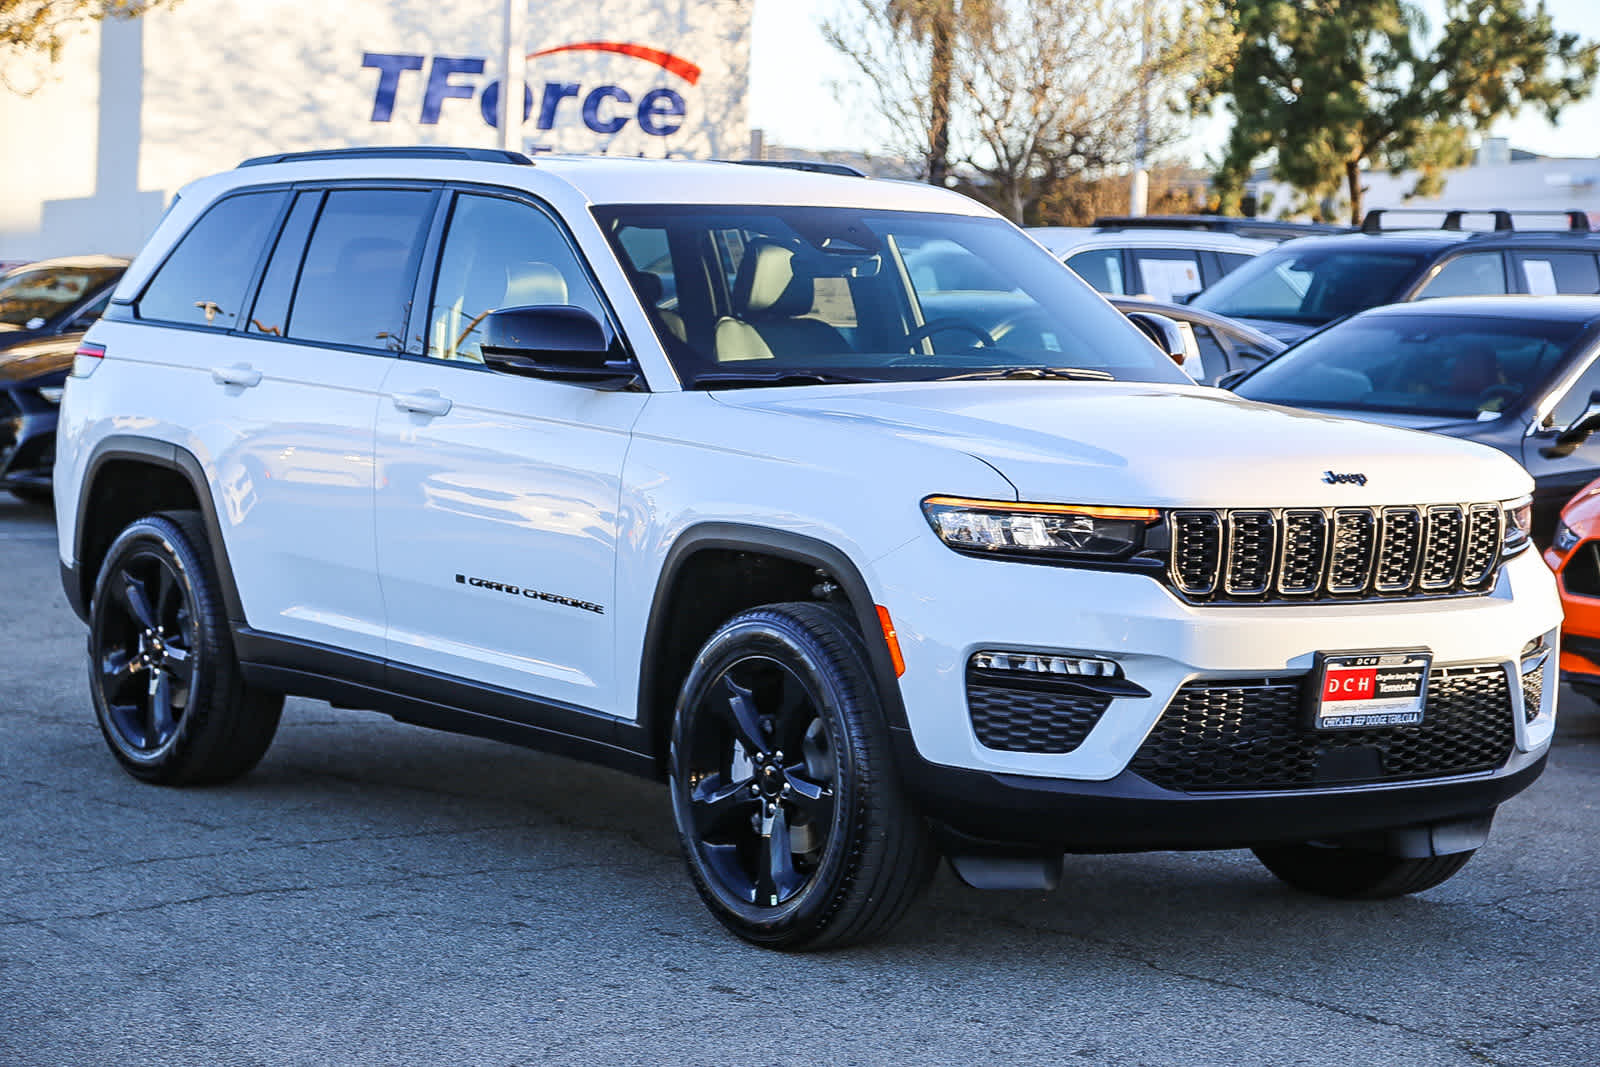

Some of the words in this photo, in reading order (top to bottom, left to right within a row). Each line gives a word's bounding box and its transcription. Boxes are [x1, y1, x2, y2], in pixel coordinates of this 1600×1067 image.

[1321, 470, 1368, 486] Jeep
[469, 577, 519, 594] GRAND
[522, 588, 605, 615] CHEROKEE
